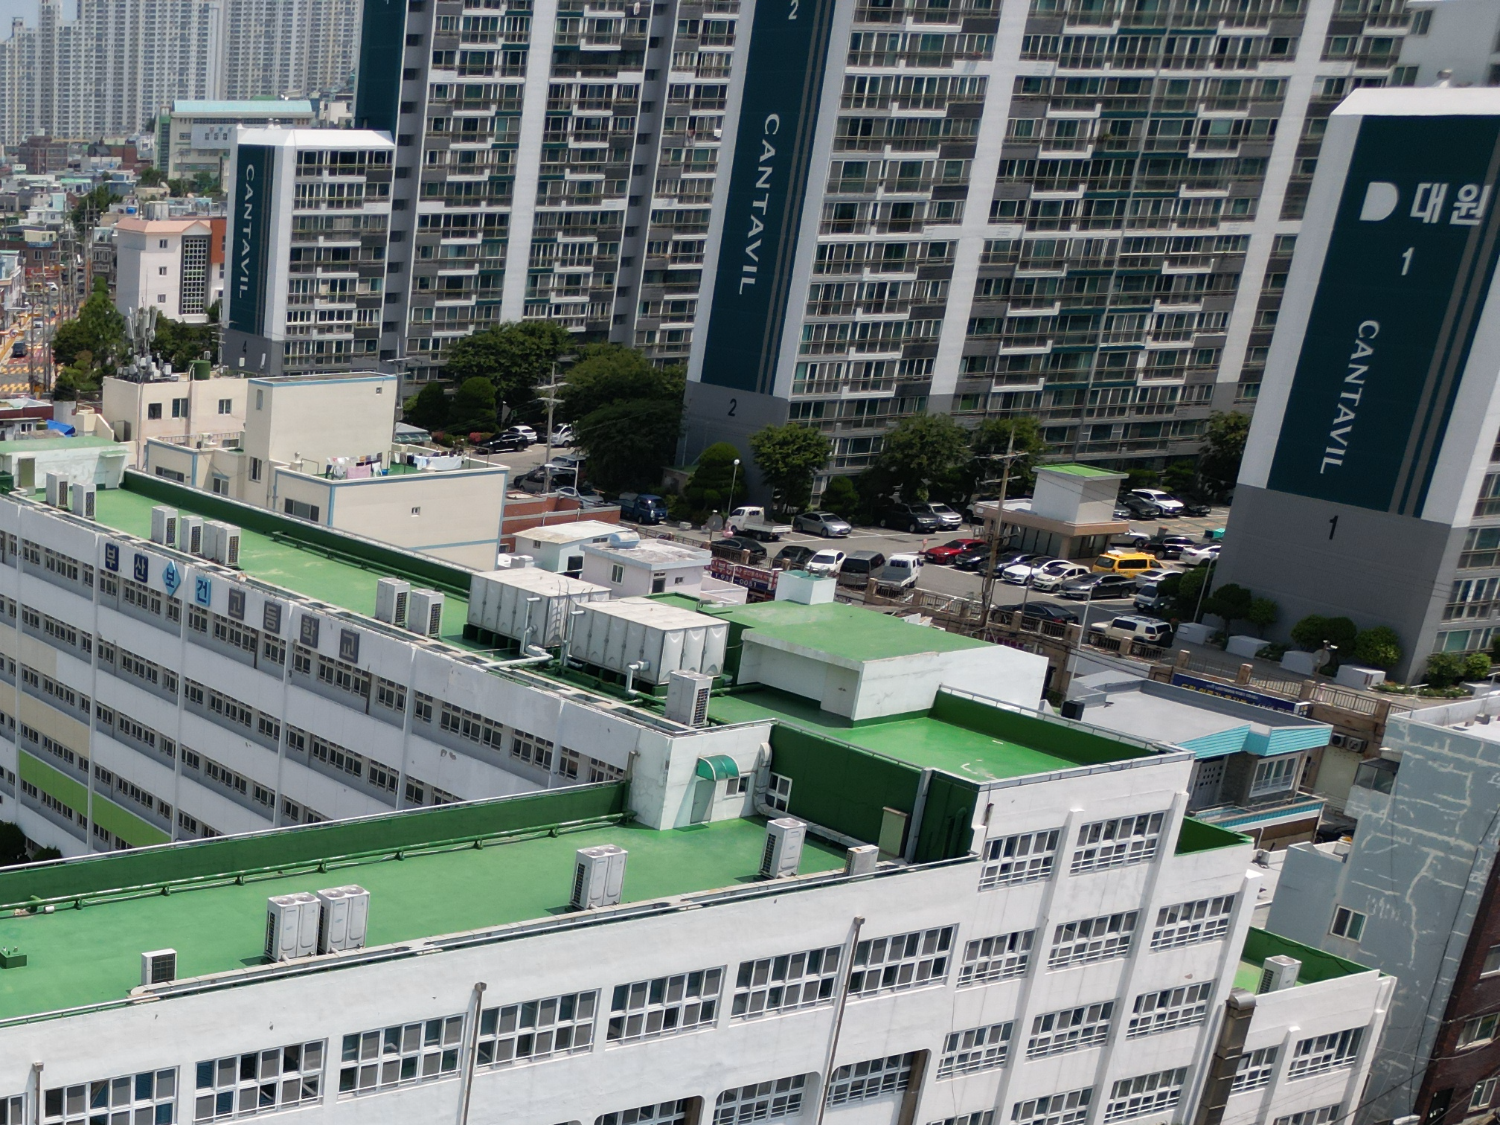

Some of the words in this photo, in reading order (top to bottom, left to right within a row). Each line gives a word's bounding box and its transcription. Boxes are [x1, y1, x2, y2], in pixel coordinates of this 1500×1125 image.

[788, 0, 799, 20] 2
[739, 114, 780, 295] CANTAVIL
[1410, 182, 1491, 226] 대원
[239, 164, 255, 299] CANTAVIL
[1401, 247, 1415, 276] 1
[728, 398, 737, 417] 2
[1320, 320, 1380, 475] CANTAVIL
[1328, 515, 1339, 540] 1
